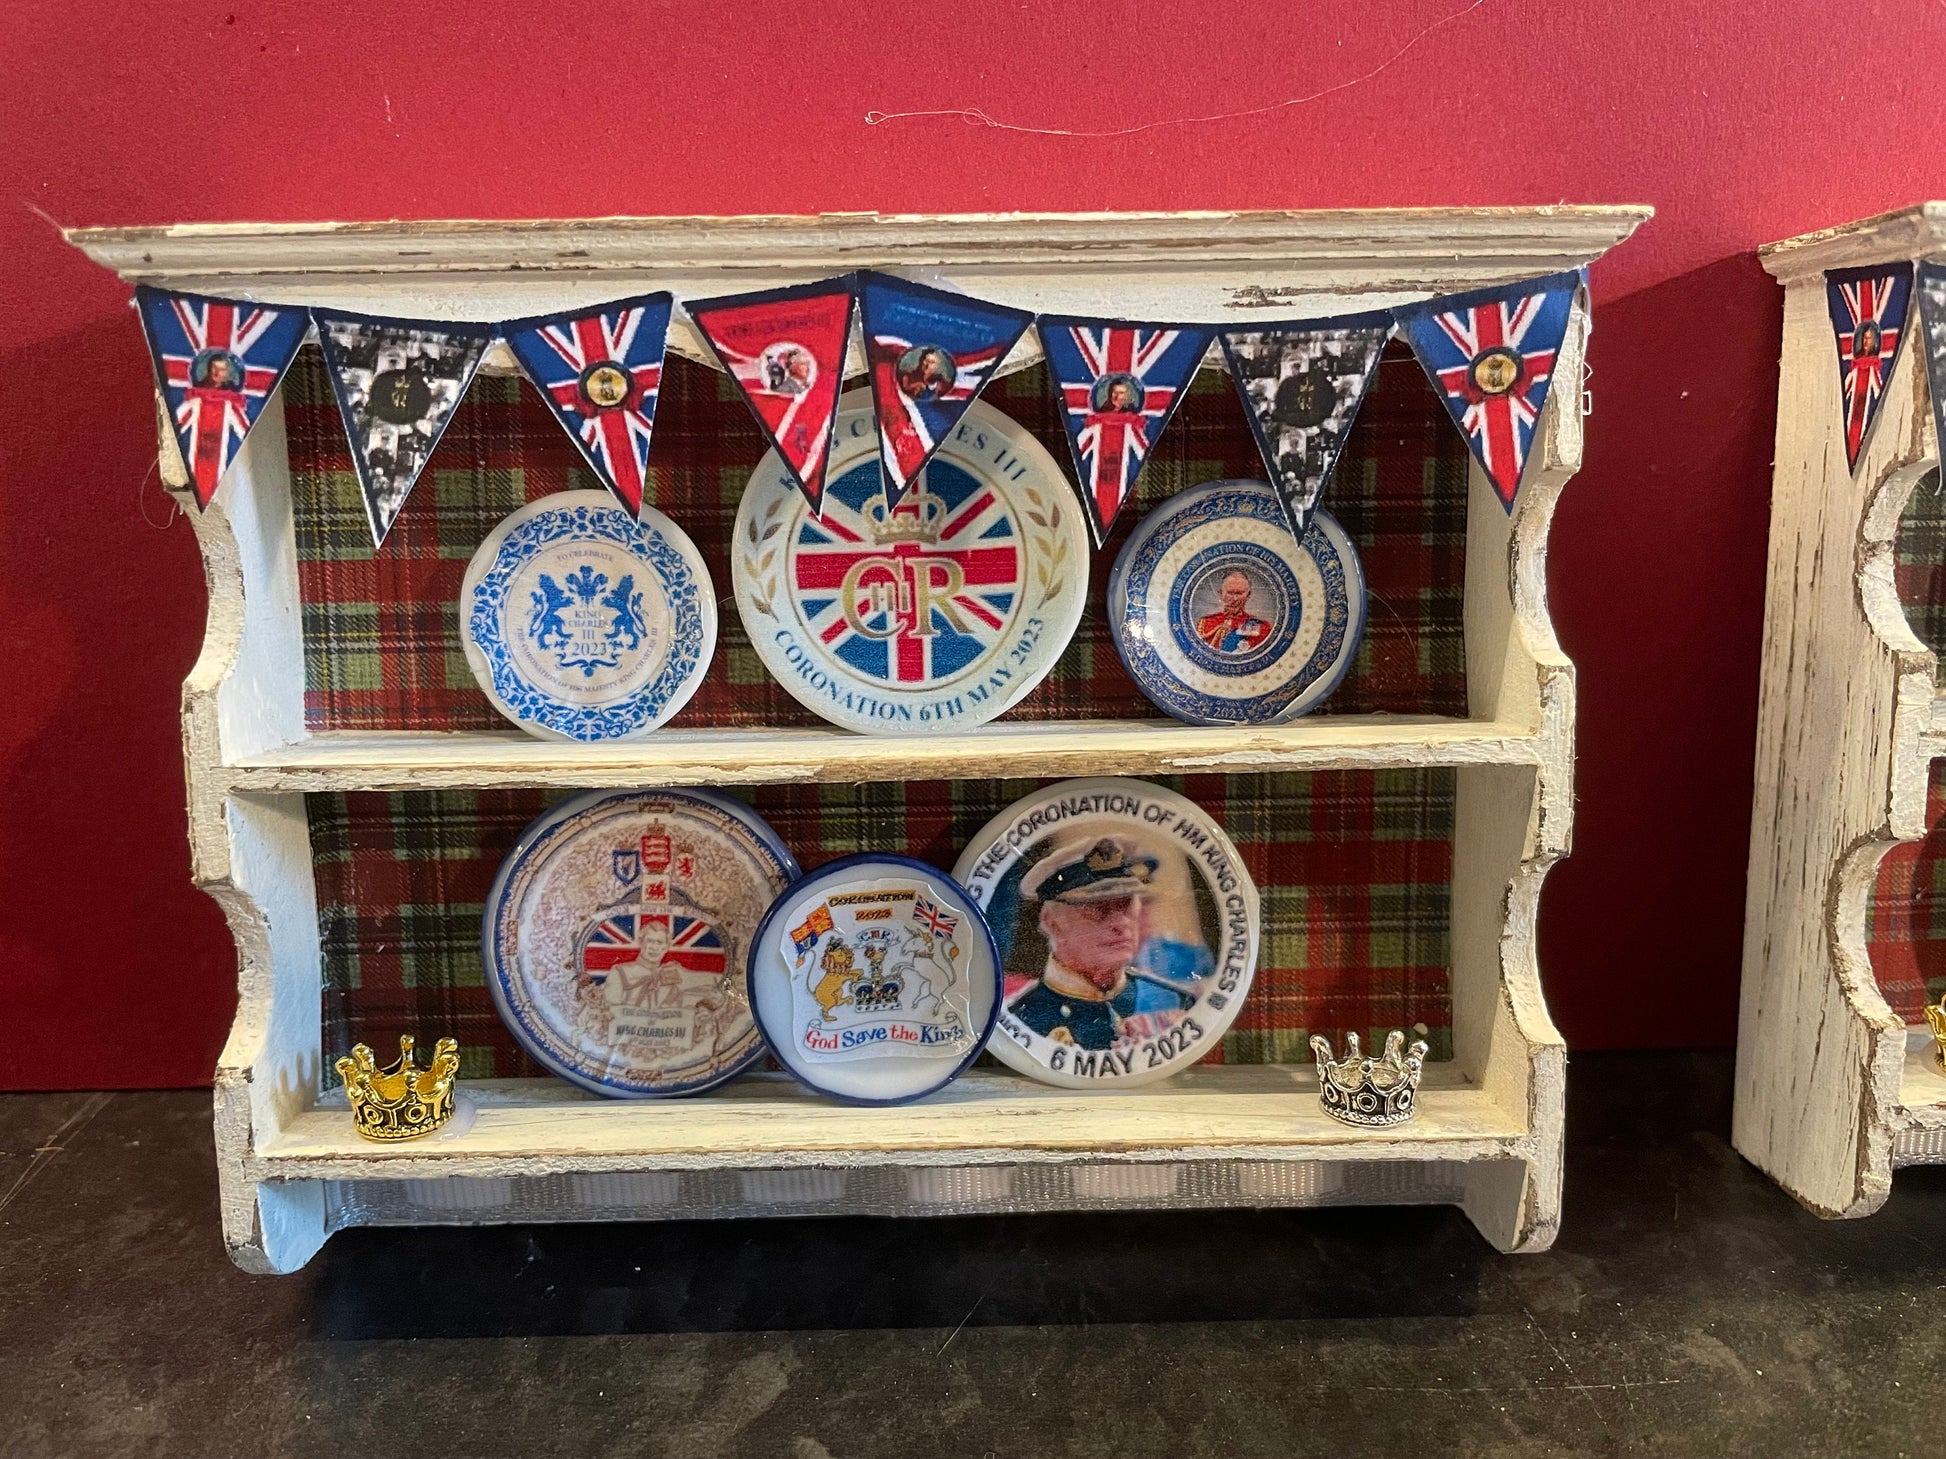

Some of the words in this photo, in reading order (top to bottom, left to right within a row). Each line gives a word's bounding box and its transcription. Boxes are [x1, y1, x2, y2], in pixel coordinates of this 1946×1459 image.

[993, 449, 1027, 482] III
[571, 642, 607, 656] 2023
[582, 629, 595, 640] III
[774, 629, 912, 722] CORONATION
[919, 700, 965, 723] 6TH
[965, 667, 1014, 705] MAY
[1011, 617, 1045, 667] 2023
[1006, 794, 1142, 847] CORONATION
[1143, 804, 1176, 826] OF
[1173, 817, 1208, 850] HM
[1202, 849, 1238, 894] KING
[1217, 895, 1247, 993] CHARLES
[806, 1030, 840, 1050] God
[842, 1025, 888, 1049] Save
[888, 1024, 919, 1042] the
[1049, 1050, 1066, 1071] 6
[1073, 1050, 1135, 1079] MAY
[1143, 1017, 1205, 1069] 2023
